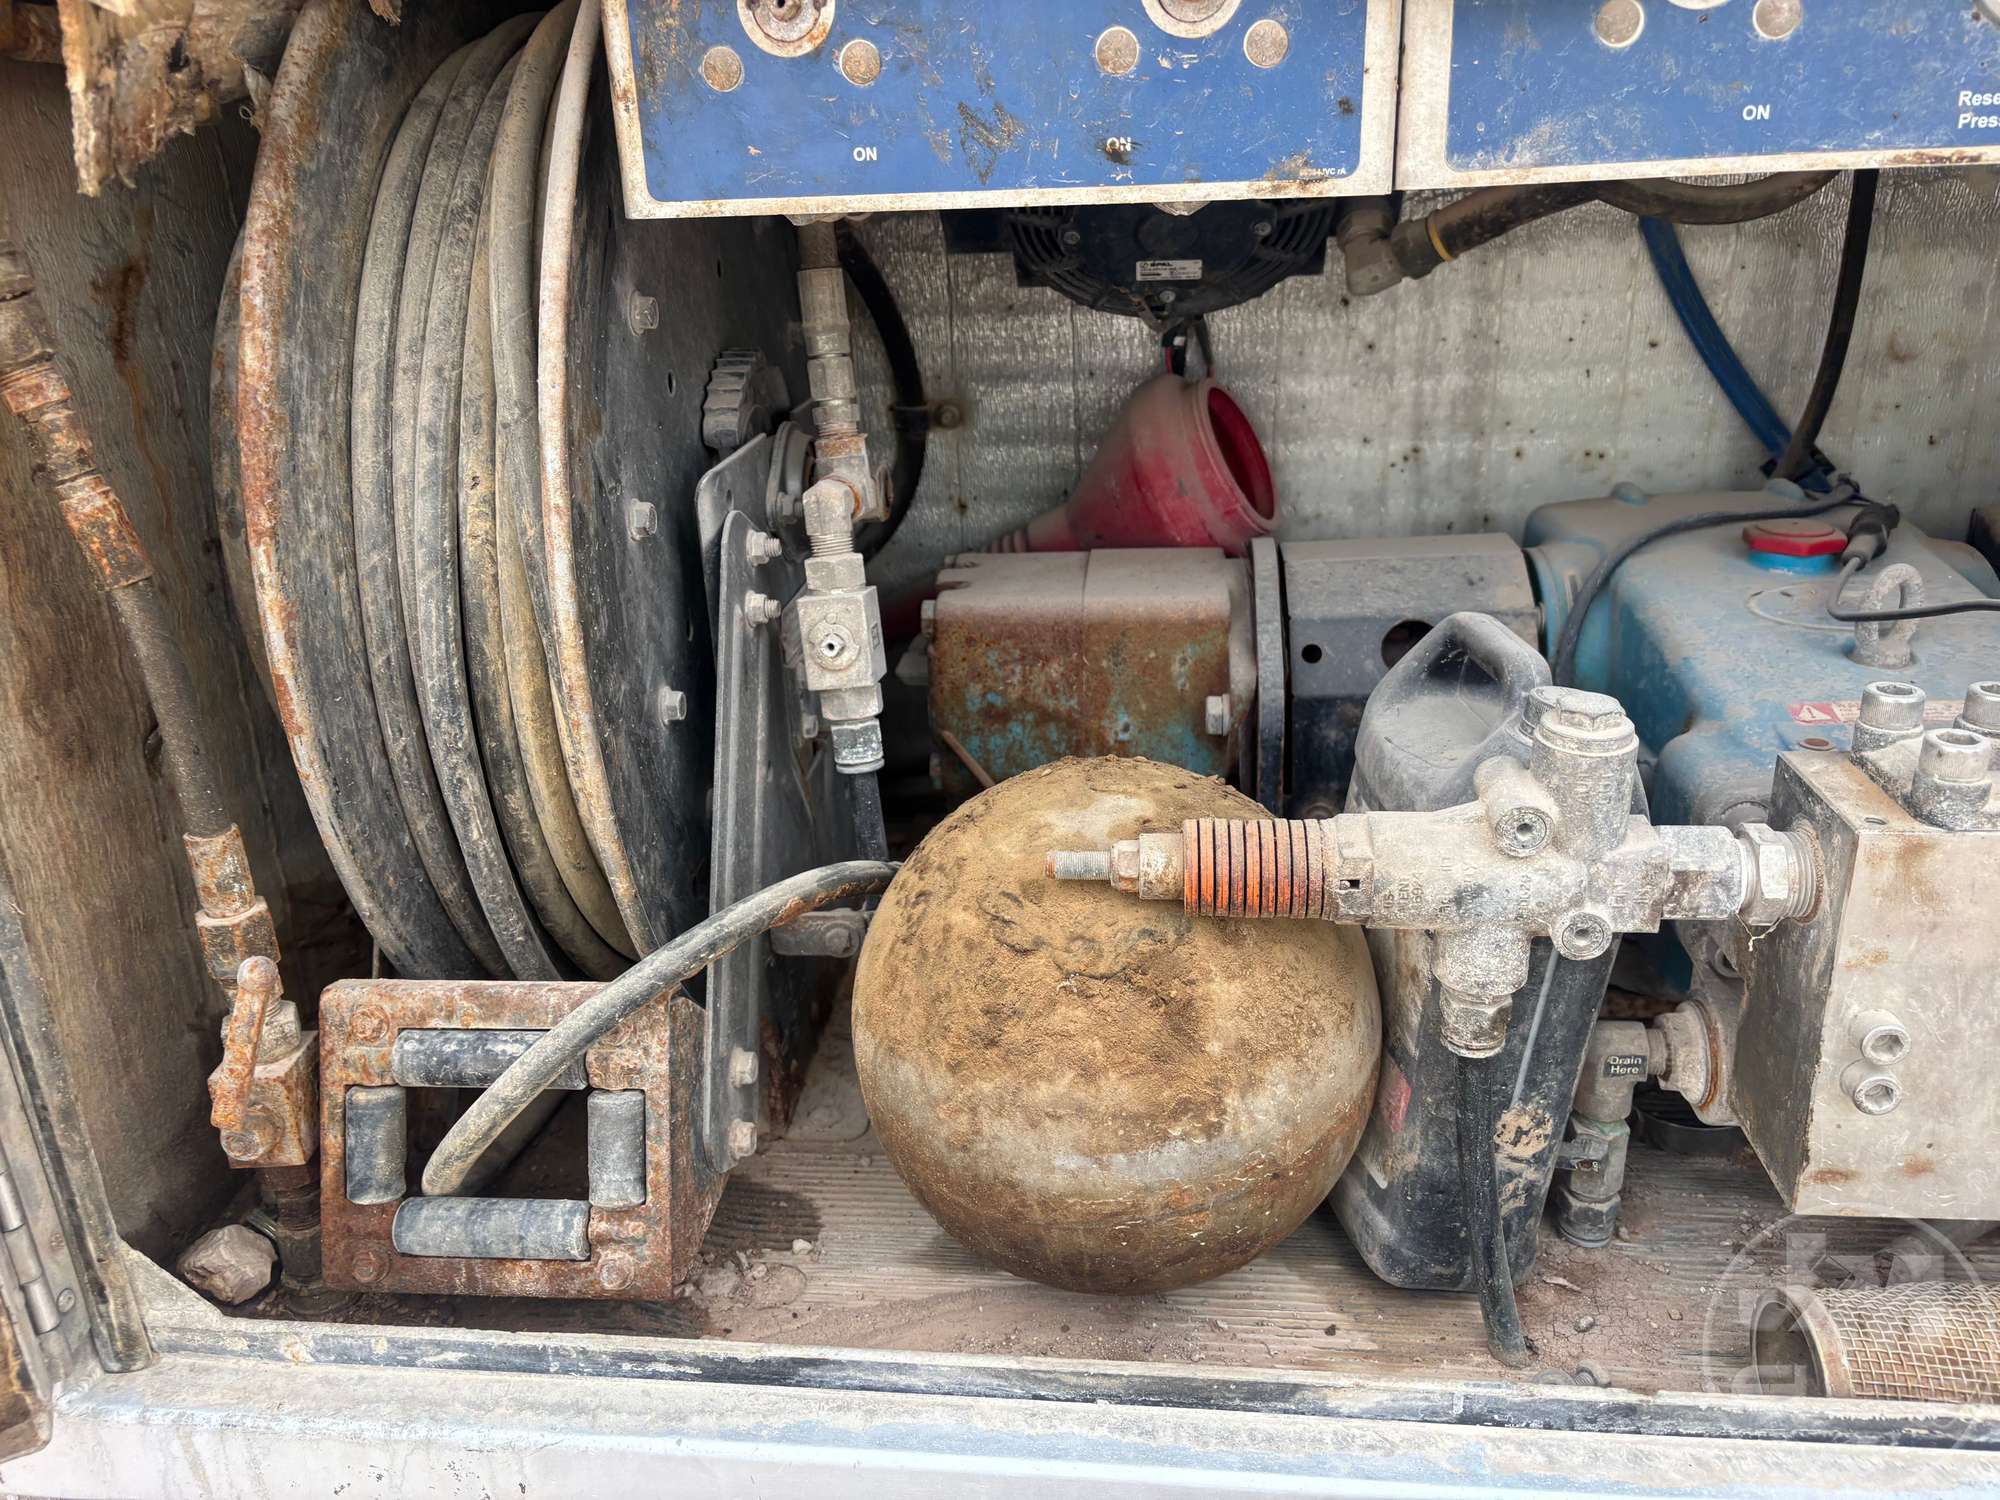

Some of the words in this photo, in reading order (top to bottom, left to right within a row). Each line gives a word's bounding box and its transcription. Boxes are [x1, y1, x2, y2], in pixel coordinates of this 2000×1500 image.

[1742, 104, 1770, 120] ON
[1958, 112, 2000, 129] Pres
[1106, 136, 1132, 151] ON
[853, 146, 878, 161] ON
[1609, 1055, 1642, 1065] Drain
[1610, 1064, 1639, 1074] Here
